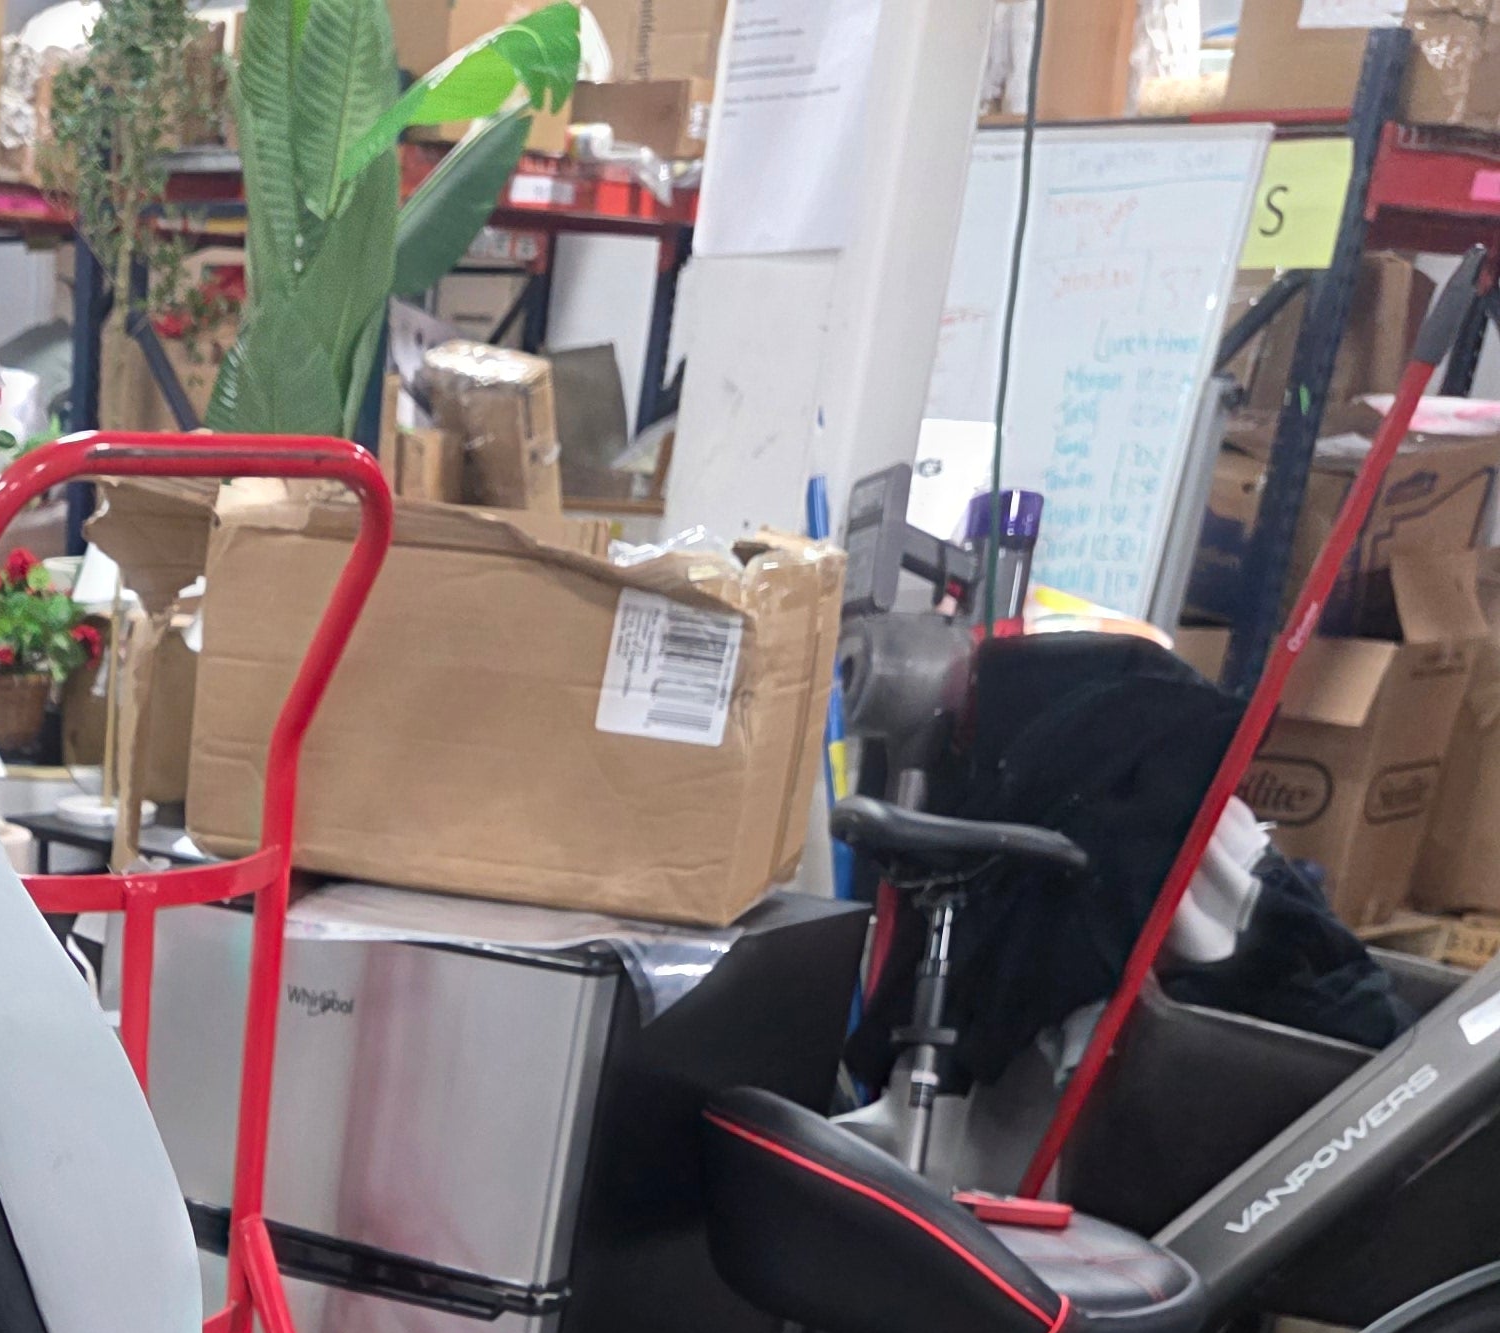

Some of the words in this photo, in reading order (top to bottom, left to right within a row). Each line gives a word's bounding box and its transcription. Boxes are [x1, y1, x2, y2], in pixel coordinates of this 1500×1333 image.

[1259, 185, 1288, 237] S
[287, 983, 355, 1016] Whirlpool
[1224, 1063, 1439, 1234] VANPOWERS
